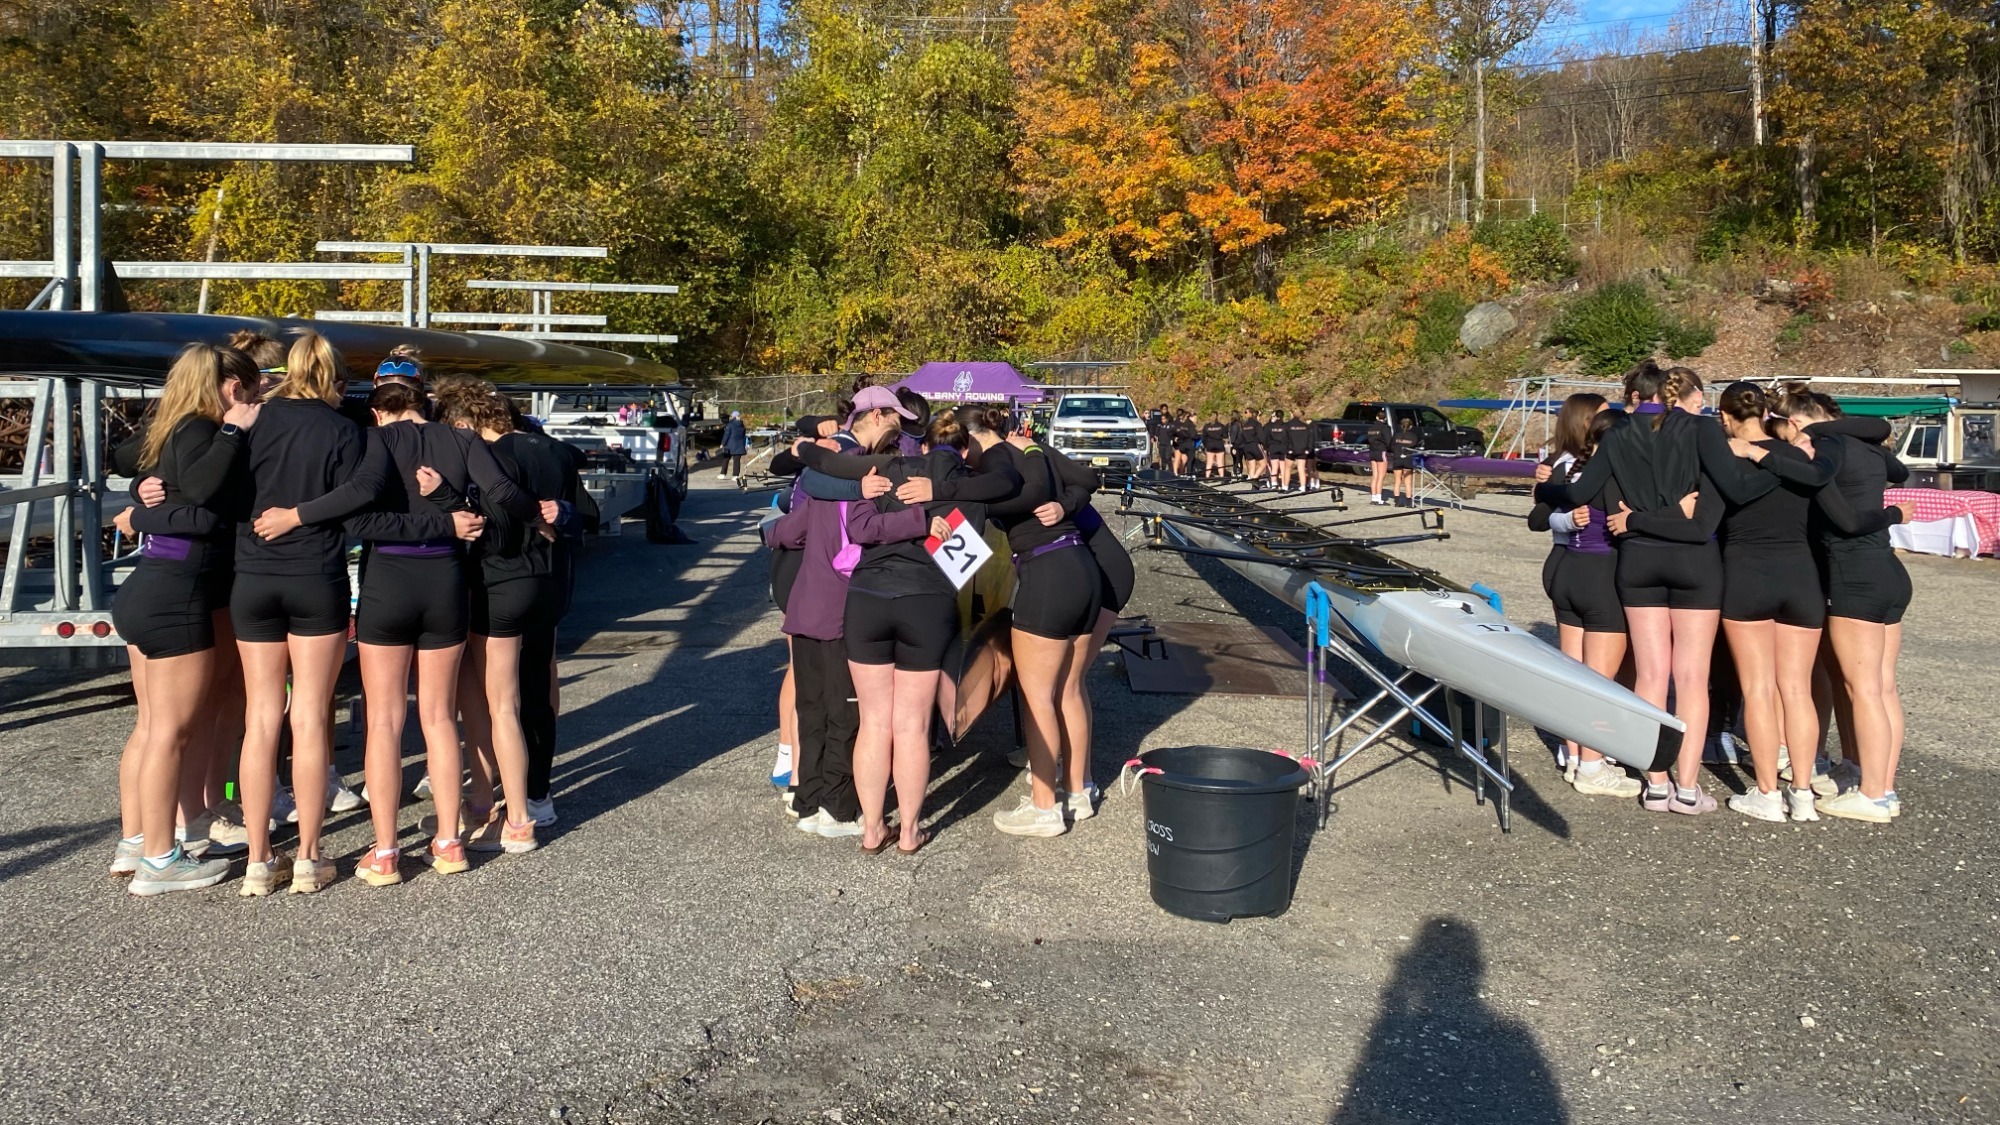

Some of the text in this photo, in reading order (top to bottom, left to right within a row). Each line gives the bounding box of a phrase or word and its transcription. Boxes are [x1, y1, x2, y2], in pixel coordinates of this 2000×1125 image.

[919, 392, 1004, 401] ALBANY ROWING
[942, 533, 978, 574] 21
